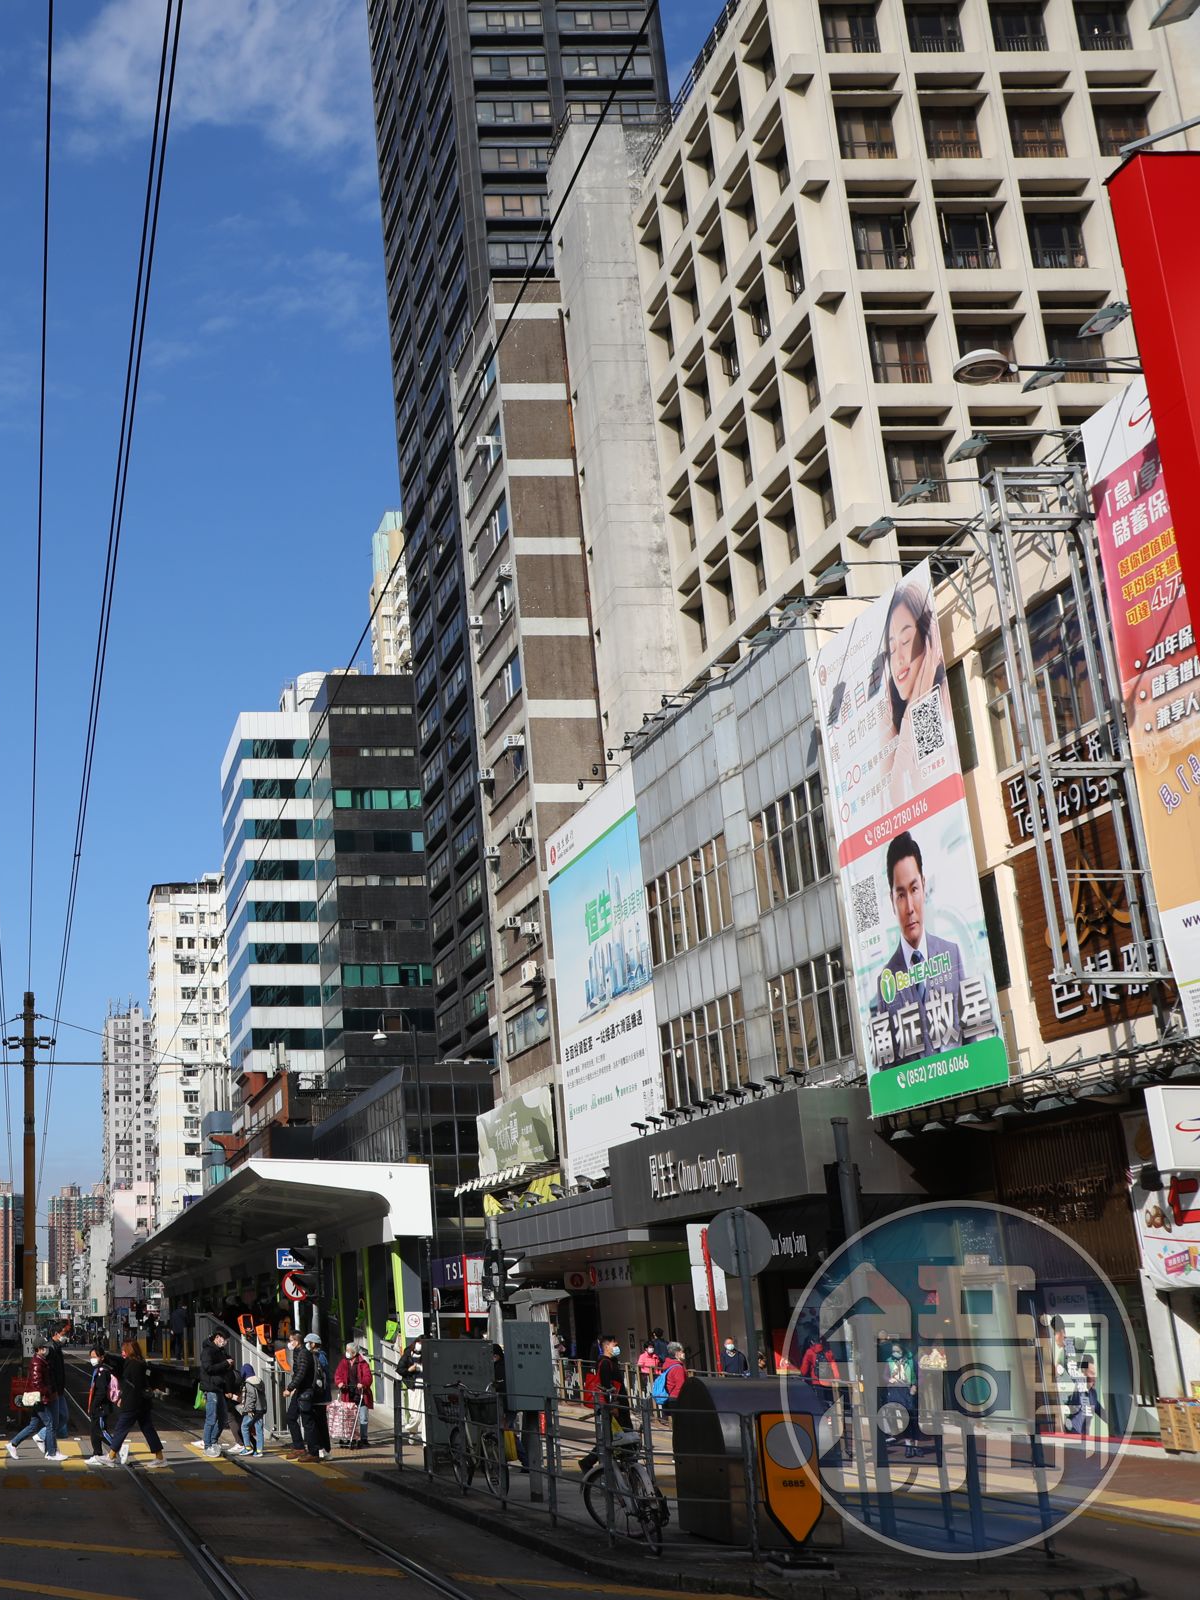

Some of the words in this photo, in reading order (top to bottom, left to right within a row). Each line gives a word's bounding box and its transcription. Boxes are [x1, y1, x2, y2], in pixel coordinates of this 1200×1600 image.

[1105, 458, 1162, 517] 「息」享
[1112, 488, 1170, 548] 儲蓄保
[1122, 552, 1181, 601] 平均每年總
[1146, 624, 1195, 668] 20年保
[873, 816, 893, 845] (852)
[892, 806, 912, 834] 2780
[911, 799, 928, 824] 1616
[896, 952, 951, 991] BeHEALTH
[869, 976, 996, 1069] 痛症救星
[906, 1067, 927, 1088] (852)
[928, 1061, 949, 1083] 2780
[948, 1056, 969, 1079] 6066
[649, 1151, 676, 1198] 周生生
[678, 1160, 698, 1192] Chow
[698, 1154, 718, 1192] Sang
[717, 1149, 739, 1188] Sang
